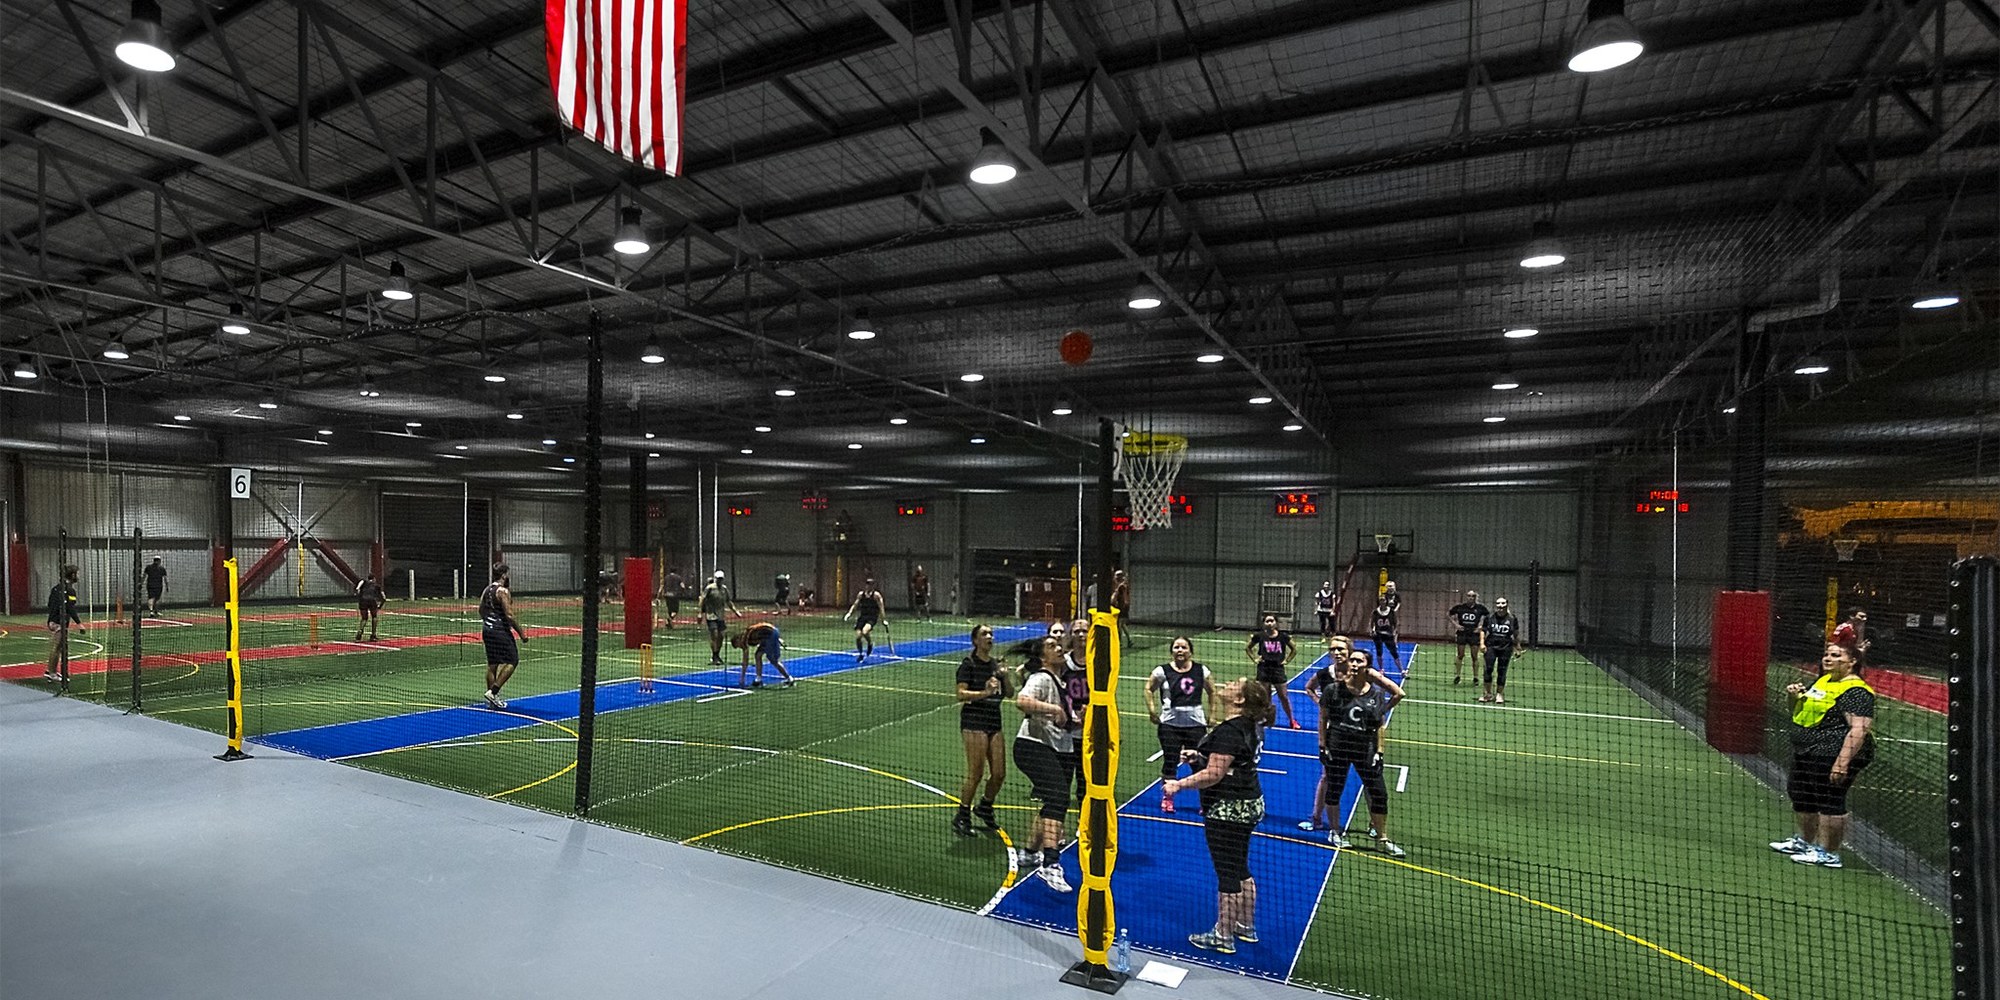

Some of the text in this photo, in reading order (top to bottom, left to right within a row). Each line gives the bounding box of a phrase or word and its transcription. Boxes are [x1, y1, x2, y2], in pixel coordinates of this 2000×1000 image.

[235, 474, 246, 494] 6
[1377, 618, 1390, 627] GA
[1462, 612, 1476, 621] GD
[1264, 641, 1283, 653] WA
[1180, 677, 1195, 695] C
[1349, 706, 1363, 722] C
